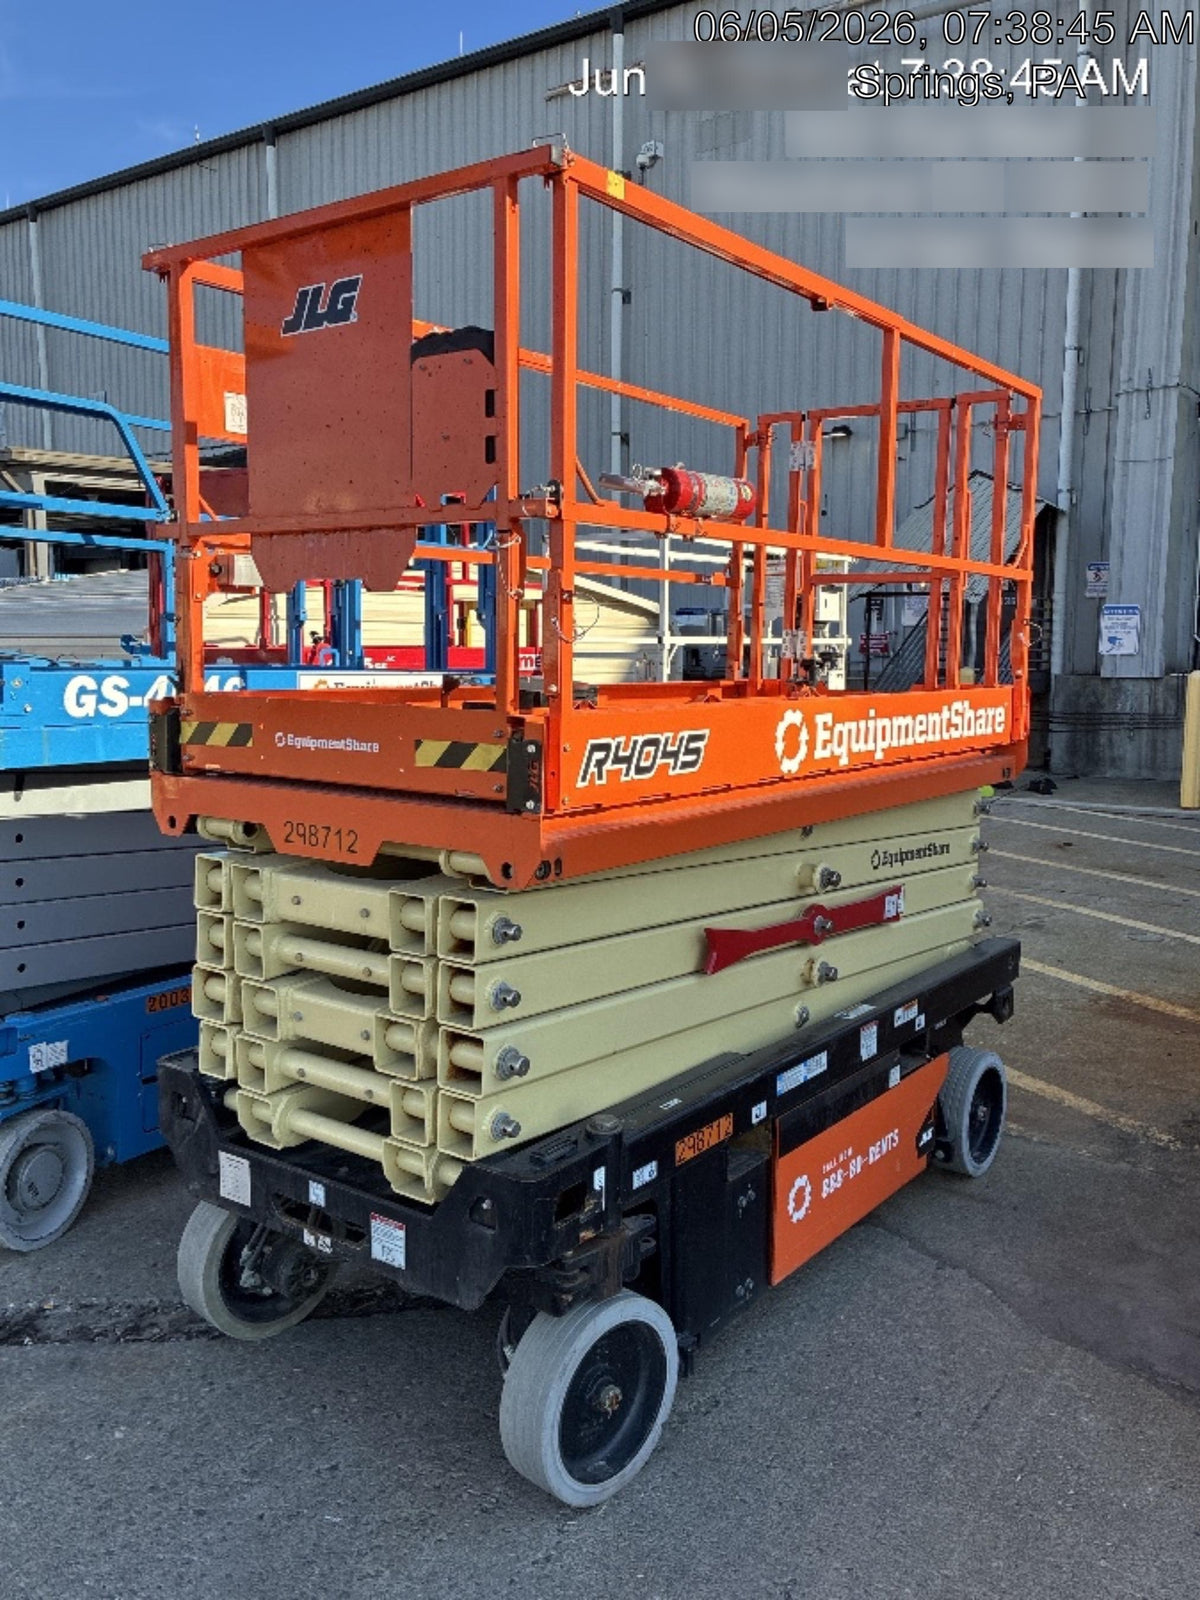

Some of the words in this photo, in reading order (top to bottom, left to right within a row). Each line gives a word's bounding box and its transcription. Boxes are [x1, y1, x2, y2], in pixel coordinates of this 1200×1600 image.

[281, 273, 363, 338] JLG
[287, 733, 380, 753] EquipmentShare
[814, 701, 1006, 766] EquipmentShare
[284, 820, 359, 854] 298712
[676, 1113, 733, 1165] 298712
